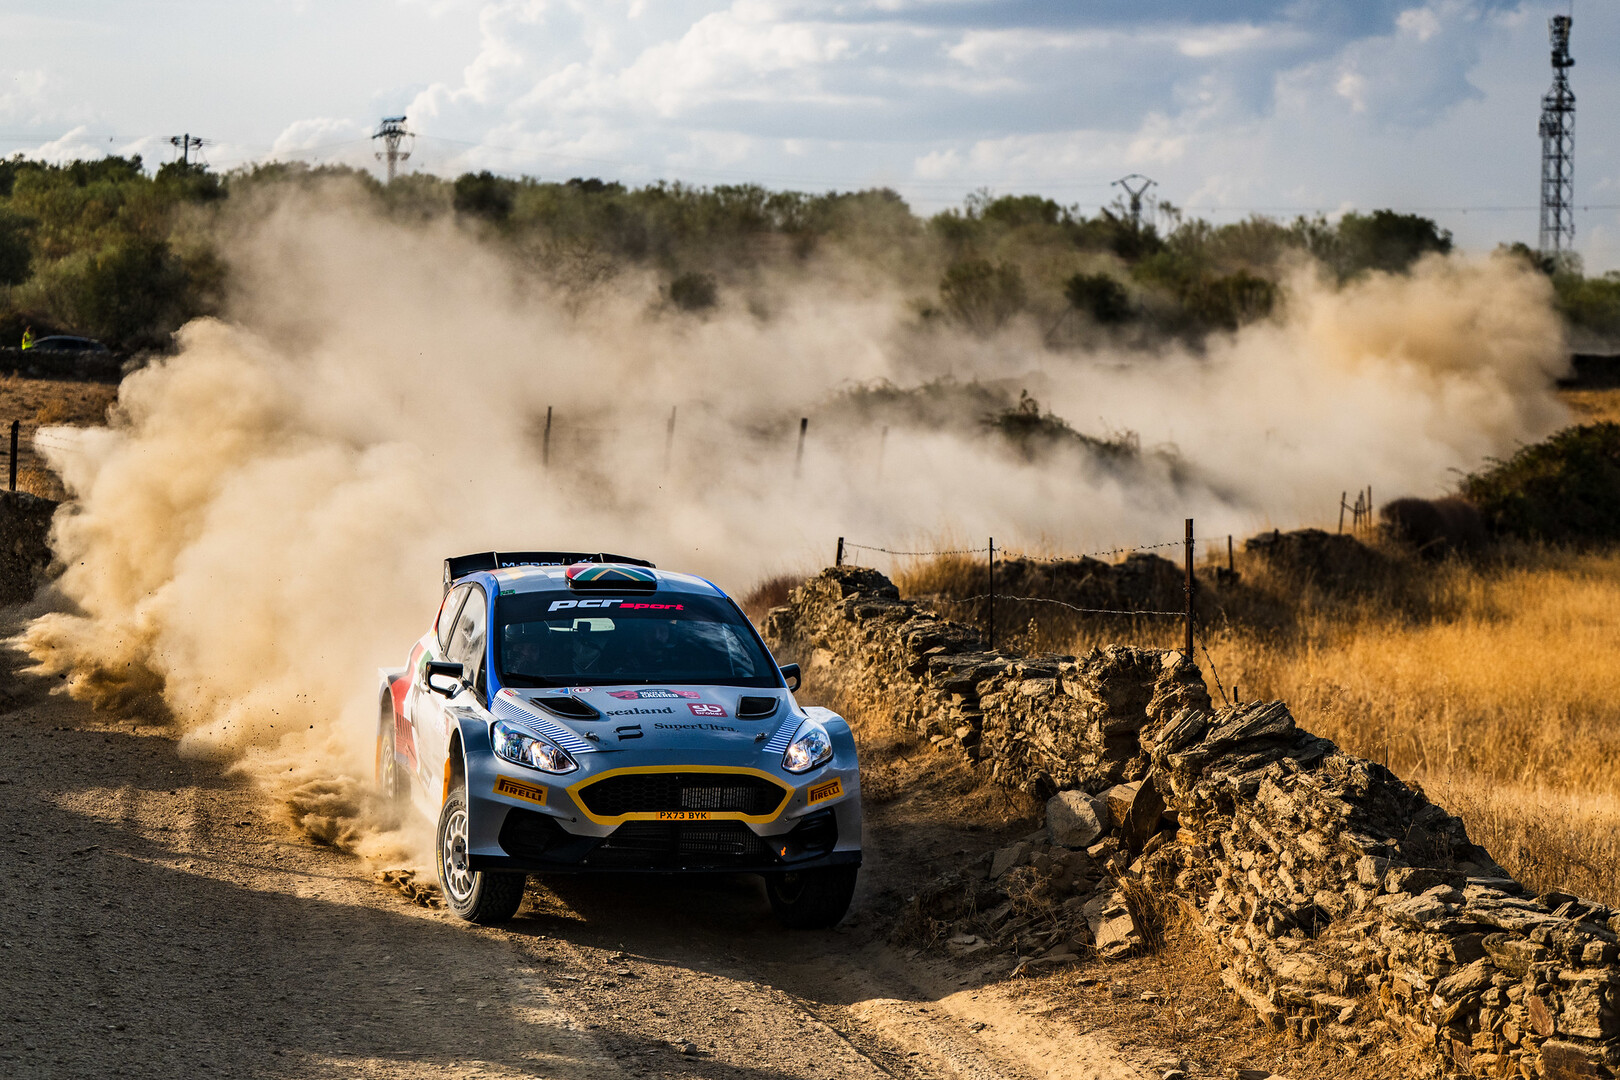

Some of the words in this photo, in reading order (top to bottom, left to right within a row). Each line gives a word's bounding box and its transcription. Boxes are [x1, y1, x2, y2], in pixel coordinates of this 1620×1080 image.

[547, 599, 624, 612] pcr
[619, 603, 684, 611] sport
[498, 778, 543, 802] PIRELLI
[810, 781, 840, 802] PIRELLI
